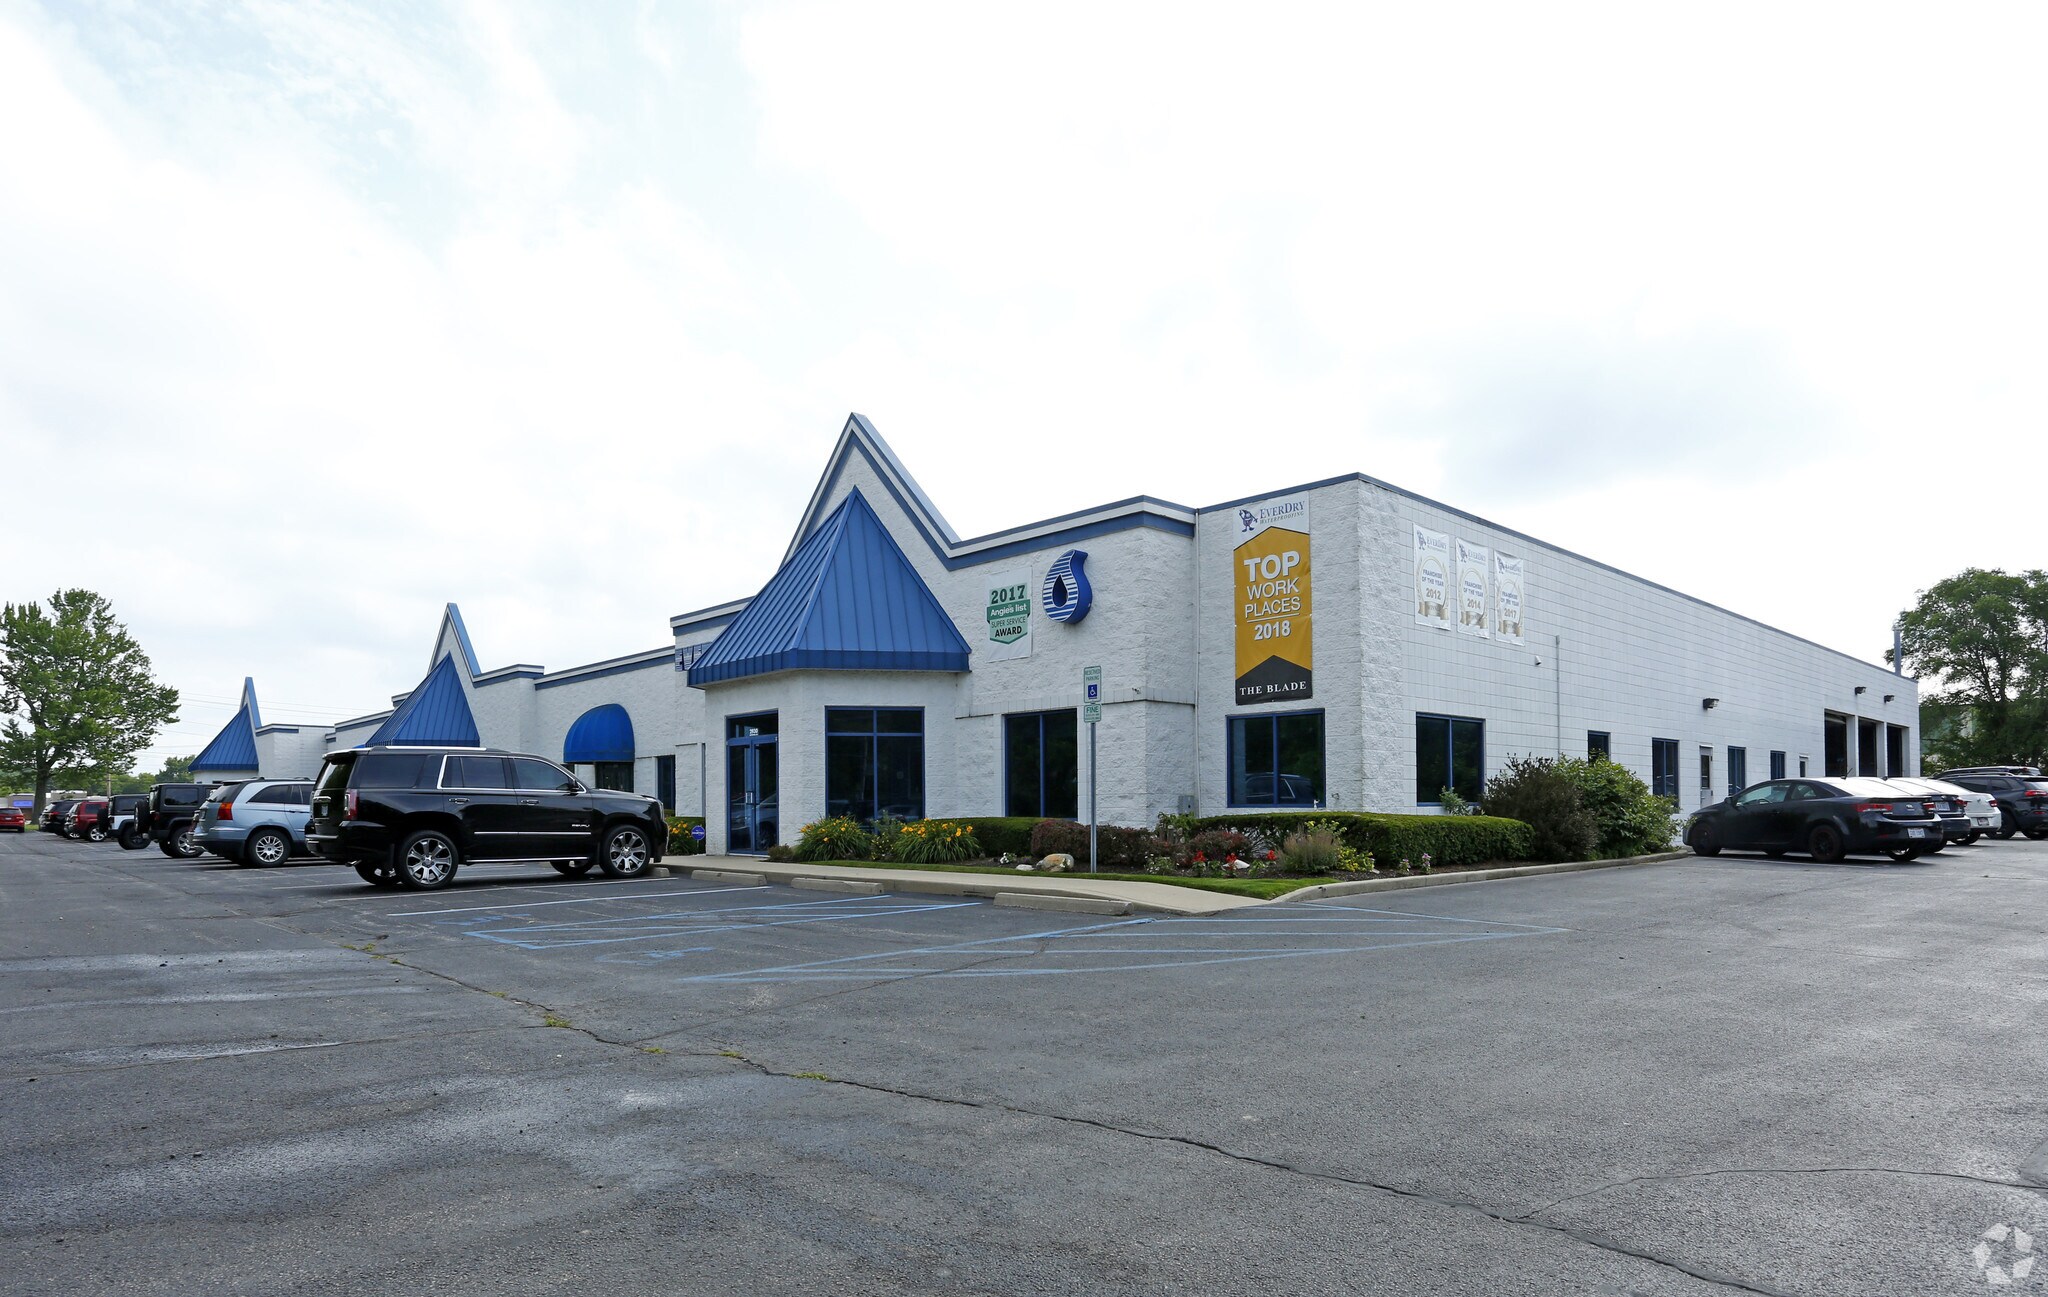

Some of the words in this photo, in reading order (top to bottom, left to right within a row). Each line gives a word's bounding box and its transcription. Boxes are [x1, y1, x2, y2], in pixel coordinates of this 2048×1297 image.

[1260, 501, 1305, 519] EVERDRY
[1244, 550, 1301, 582] TOP
[991, 585, 1025, 604] 2017
[1247, 577, 1300, 600] WORK
[1426, 588, 1442, 600] 2012
[1015, 603, 1027, 612] list
[1245, 596, 1301, 619] PLACES
[991, 619, 1005, 628] SUPER
[1006, 616, 1026, 626] SERVICE
[995, 626, 1022, 638] AWARD
[1254, 620, 1291, 641] 2018
[1240, 685, 1262, 696] THE
[1267, 681, 1307, 693] BLADE
[1087, 705, 1099, 714] FINE
